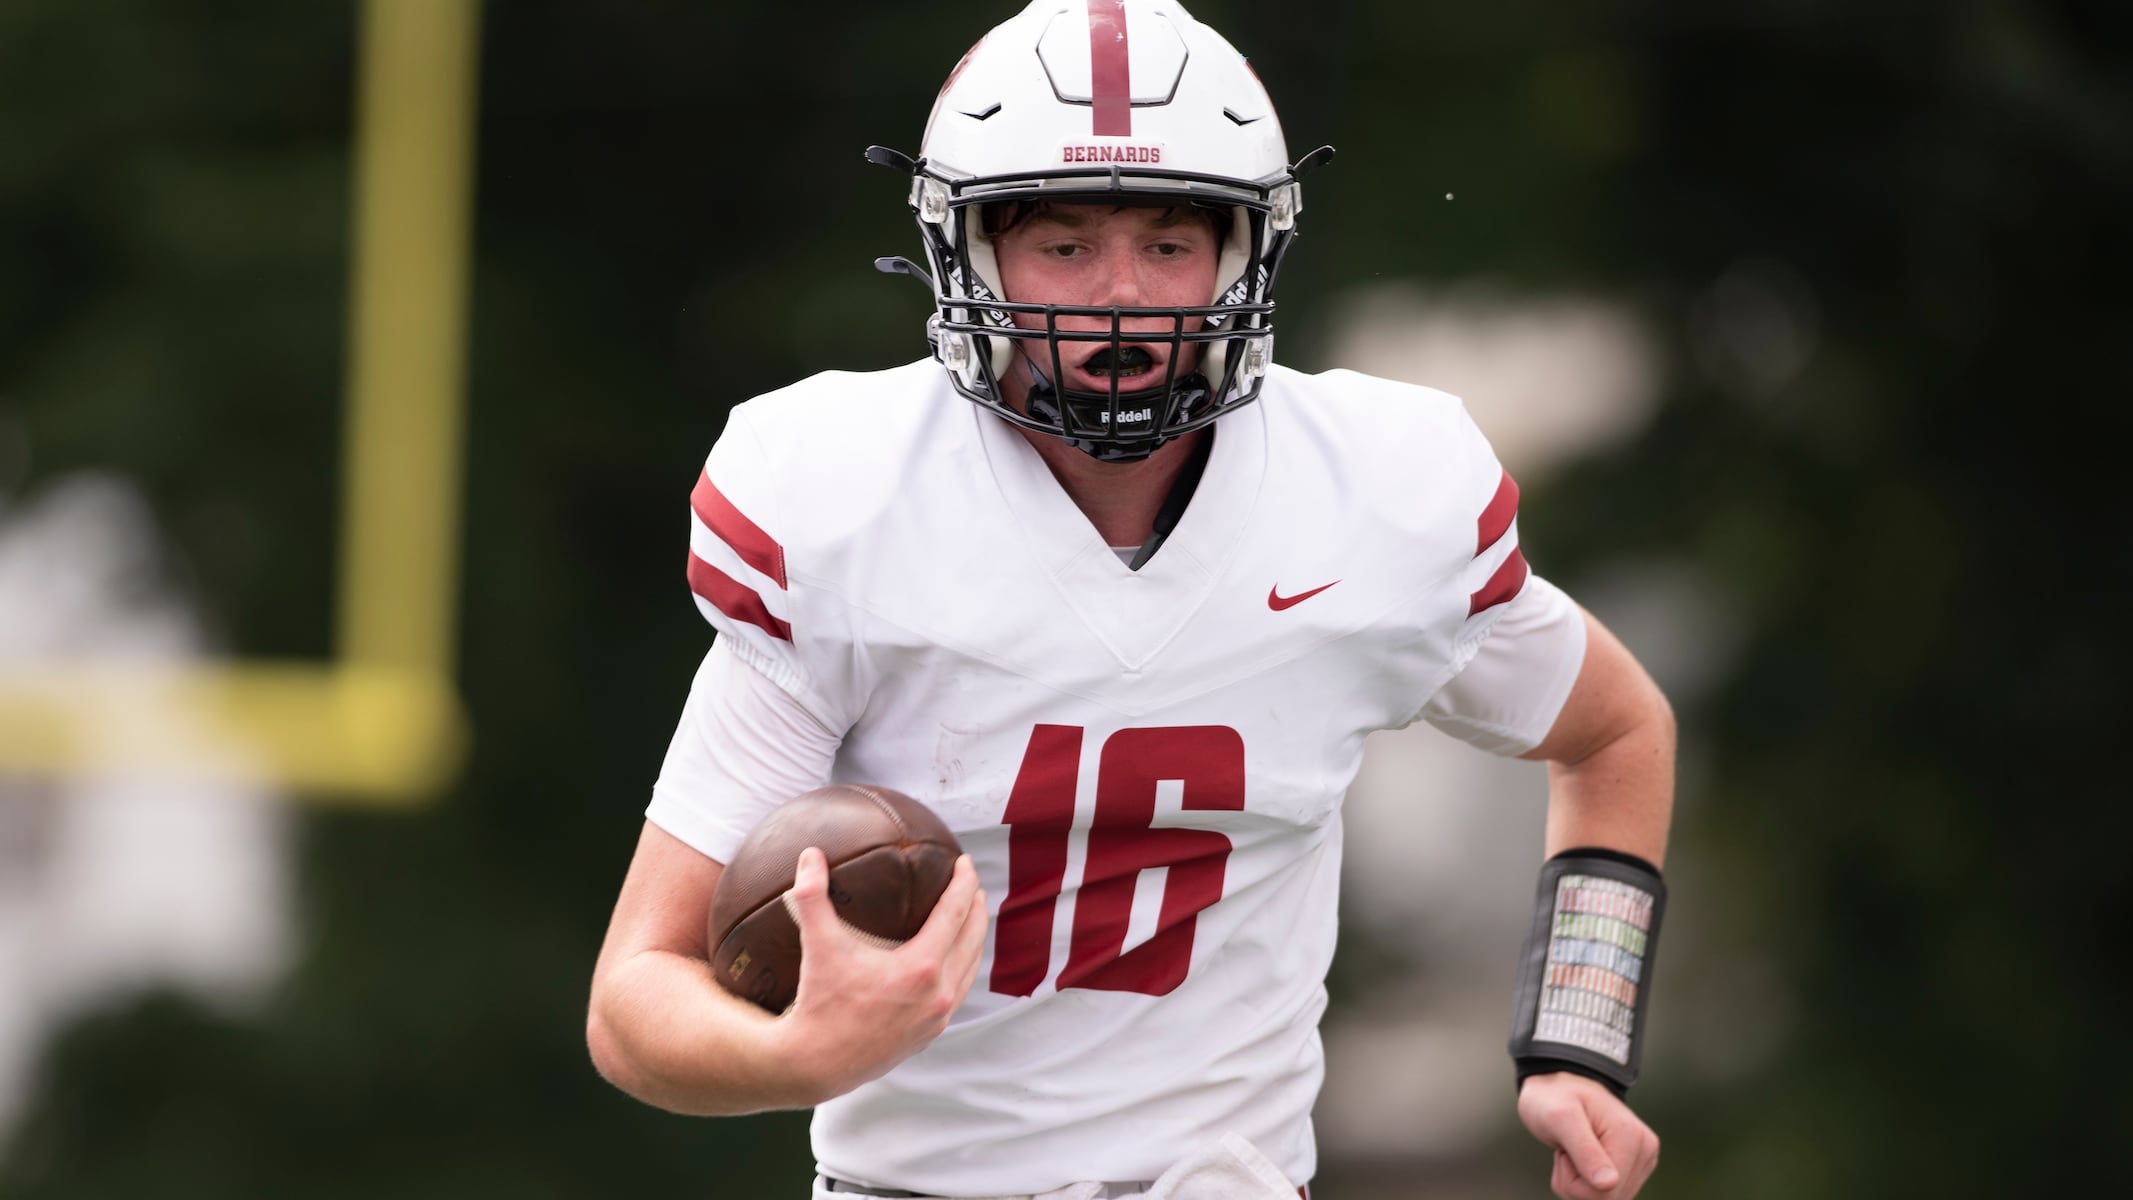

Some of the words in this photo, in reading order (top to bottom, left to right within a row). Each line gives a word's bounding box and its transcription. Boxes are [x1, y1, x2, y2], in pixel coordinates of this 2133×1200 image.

[1063, 146, 1160, 163] BERNARDS
[1101, 408, 1152, 424] Rddell
[989, 723, 1245, 998] 16
